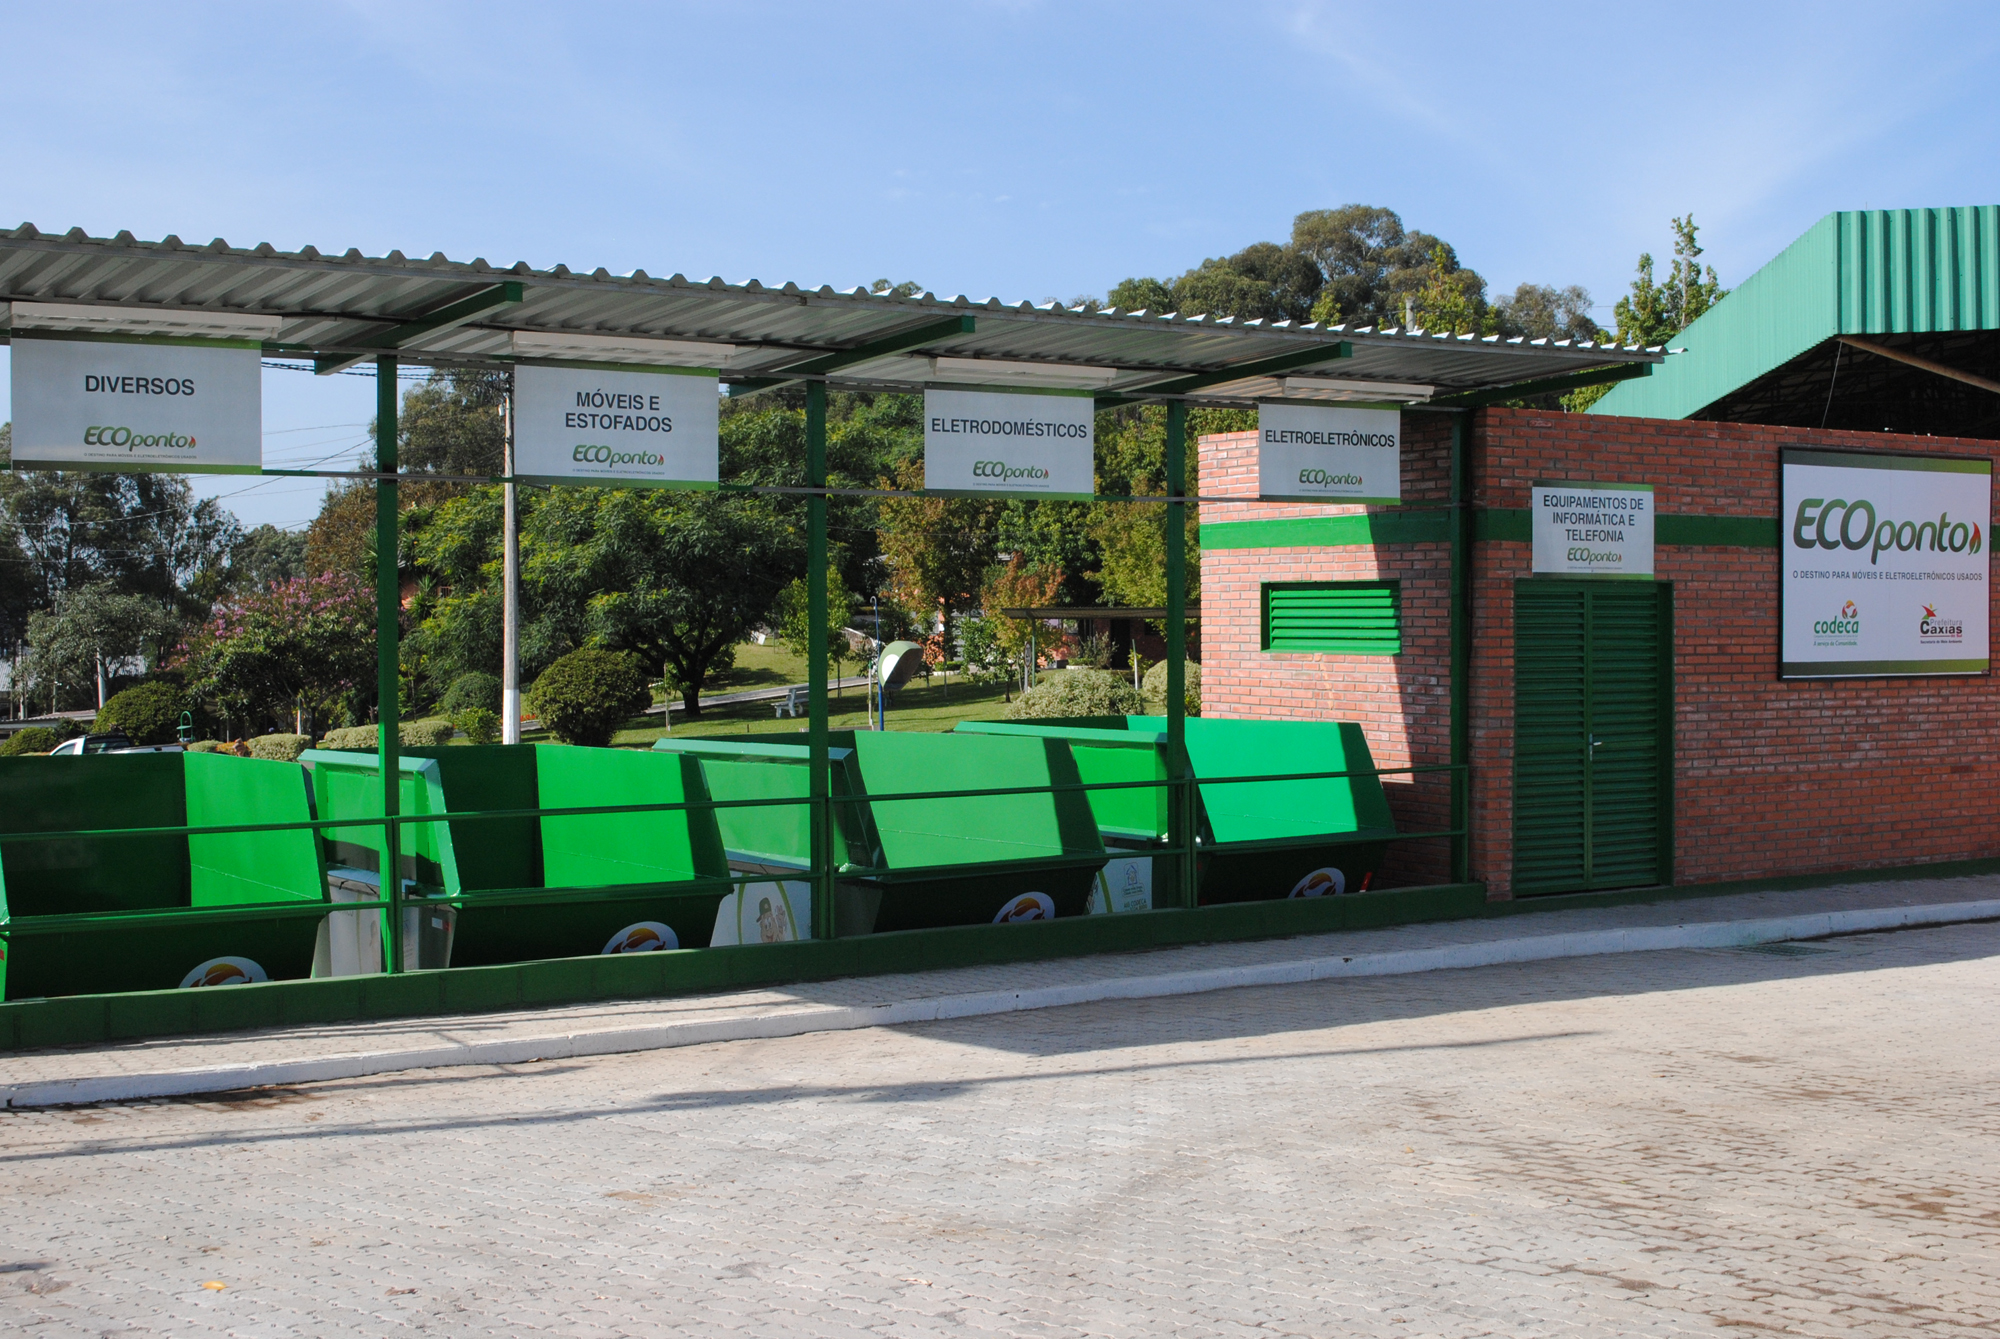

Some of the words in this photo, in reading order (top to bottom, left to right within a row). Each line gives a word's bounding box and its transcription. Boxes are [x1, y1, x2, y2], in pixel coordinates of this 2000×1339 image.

[85, 374, 195, 396] DIVERSOS
[576, 388, 644, 411] MÓVEIS
[650, 395, 660, 411] E
[565, 412, 672, 433] ESTOFADOS
[931, 418, 1087, 438] ELETRODOMÉSTICOS
[83, 425, 189, 452] ECOponto
[1265, 429, 1395, 447] ELETROELETRÔNICOS
[572, 444, 658, 468] ECOponto
[972, 460, 1044, 482] ECOponto
[1298, 468, 1358, 488] ECOponto
[1543, 494, 1627, 510] EQUIPAMENTOS
[1630, 498, 1644, 510] DE
[1552, 510, 1626, 526] INFORMÁTICA
[1628, 514, 1635, 526] E
[1565, 529, 1624, 542] TELEFONIA
[1793, 497, 1969, 565] ECOponto
[1567, 547, 1618, 565] ECOponto
[1793, 570, 1798, 579] O
[1800, 570, 1830, 579] DESTINO
[1832, 571, 1850, 579] PARA
[1852, 569, 1878, 580] MÓVEIS
[1879, 571, 1884, 580] E
[1885, 570, 1955, 581] ELETROELETRÔNICOS
[1957, 572, 1983, 581] USADOS
[1813, 615, 1859, 634] codeca
[1920, 620, 1963, 634] Caxias
